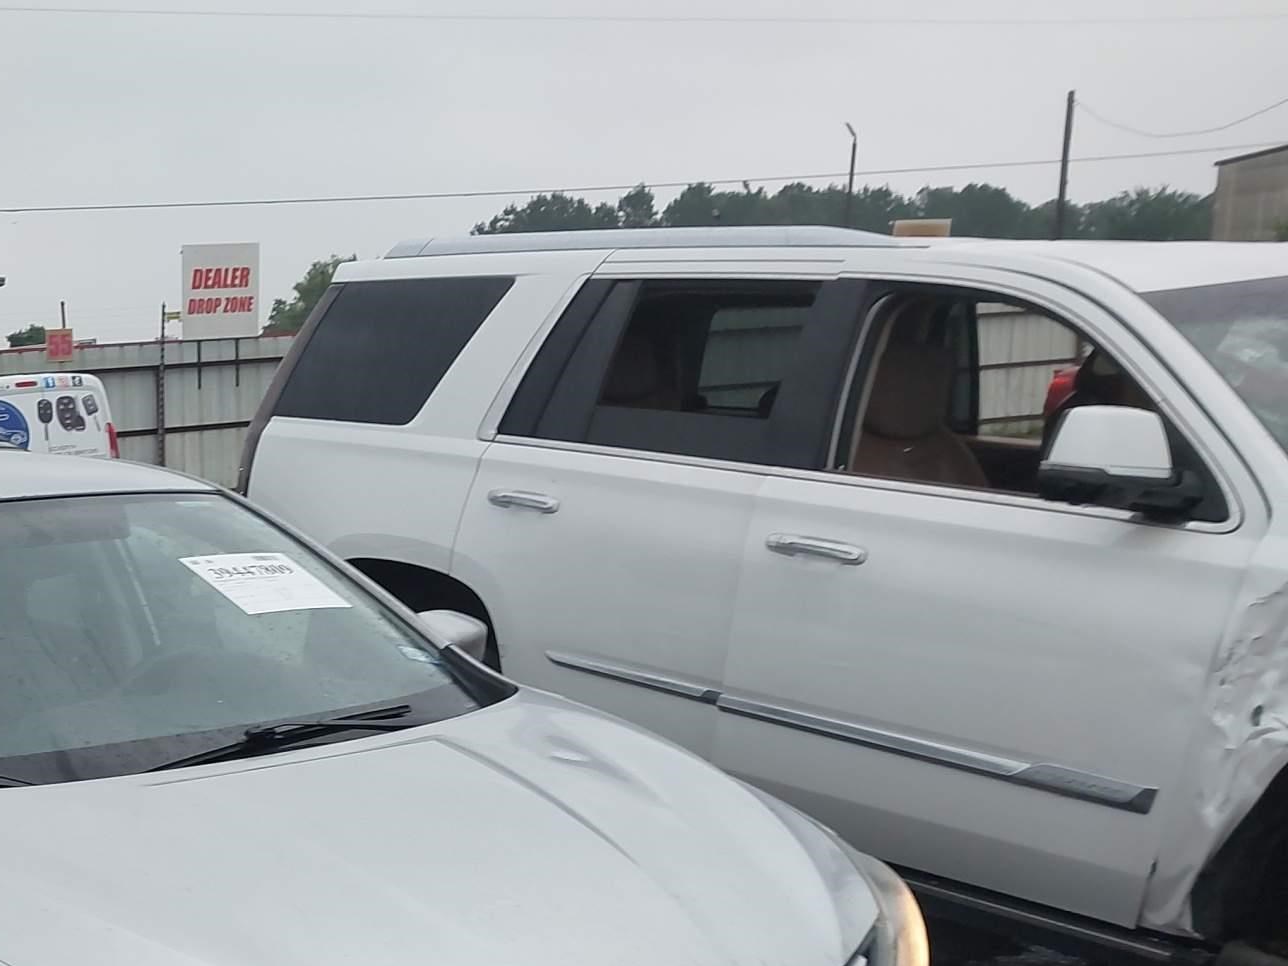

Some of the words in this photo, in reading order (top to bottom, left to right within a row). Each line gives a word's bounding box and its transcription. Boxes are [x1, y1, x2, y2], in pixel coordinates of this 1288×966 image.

[191, 266, 250, 290] DEALER
[187, 297, 222, 315] DROP
[223, 296, 254, 313] ZONE
